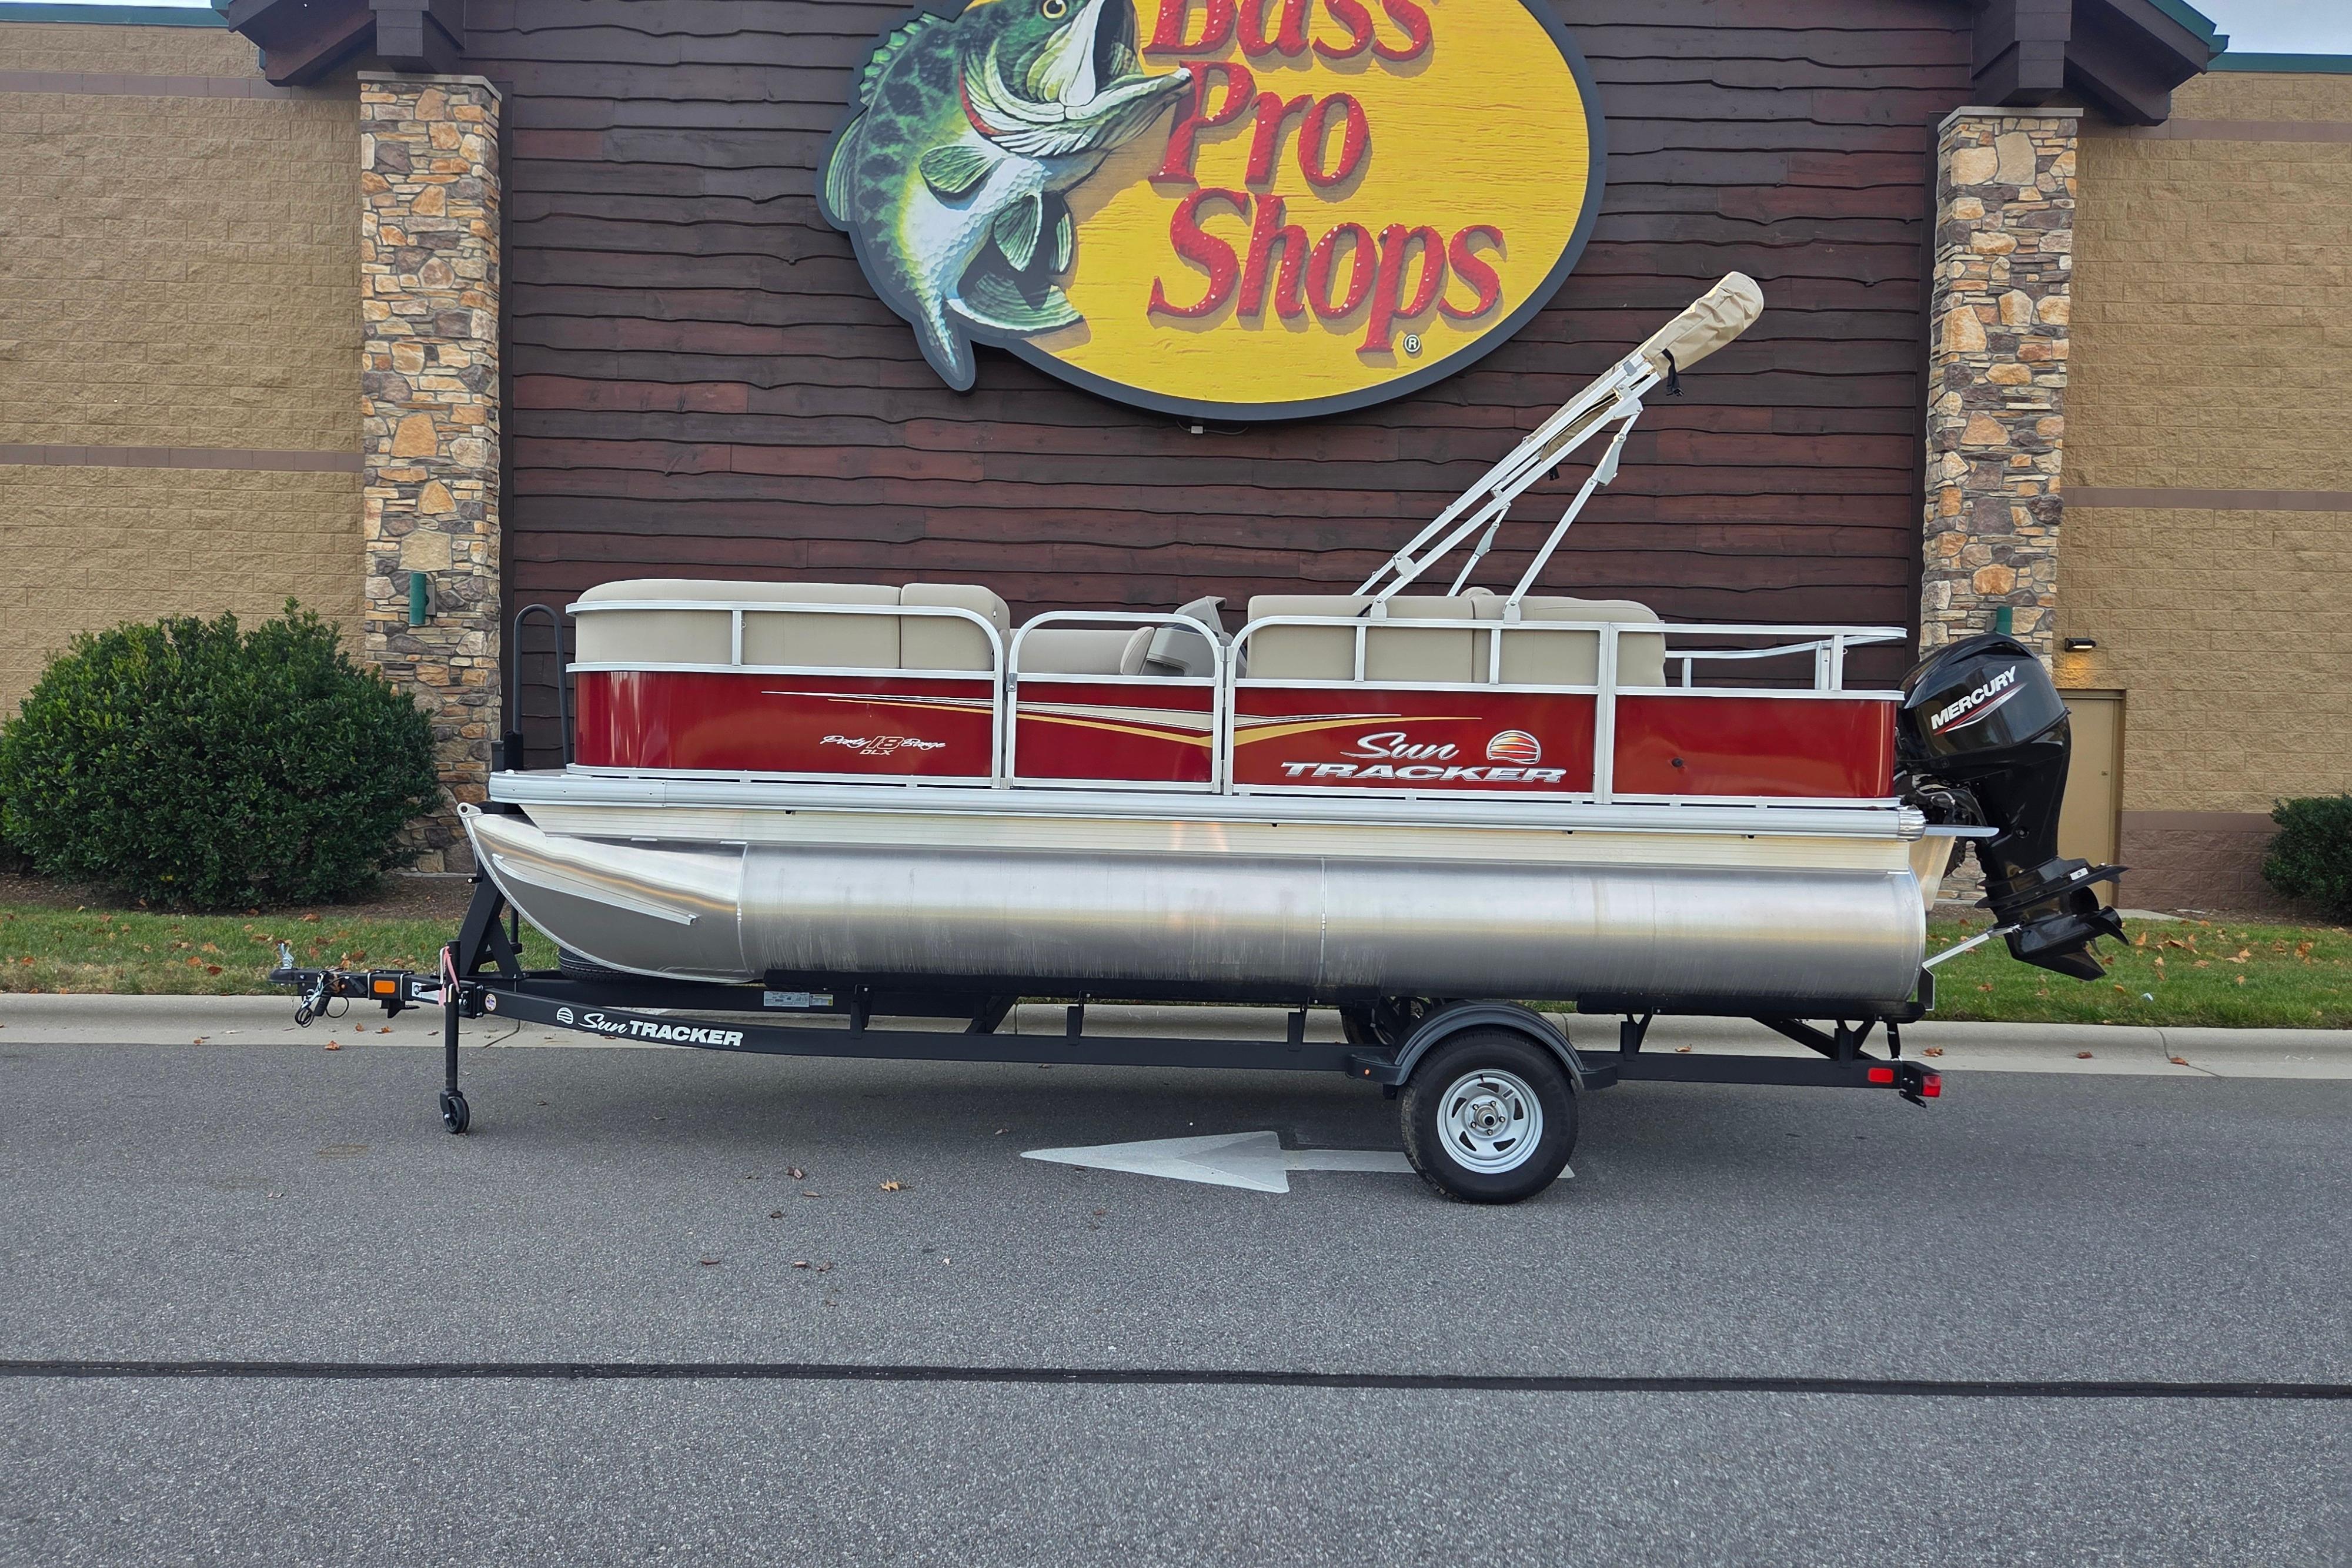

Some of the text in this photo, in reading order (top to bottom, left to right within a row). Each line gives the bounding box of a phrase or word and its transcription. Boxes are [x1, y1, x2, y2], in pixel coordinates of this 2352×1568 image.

[1148, 60, 1370, 187] Pro
[1148, 188, 1504, 353] Shops
[1931, 666, 2016, 730] MERCURY
[820, 735, 946, 750] Party 18 Barge
[1339, 732, 1459, 759] Sun
[1281, 762, 1566, 783] TRACKER
[578, 1013, 743, 1046] Sun TRACKER
